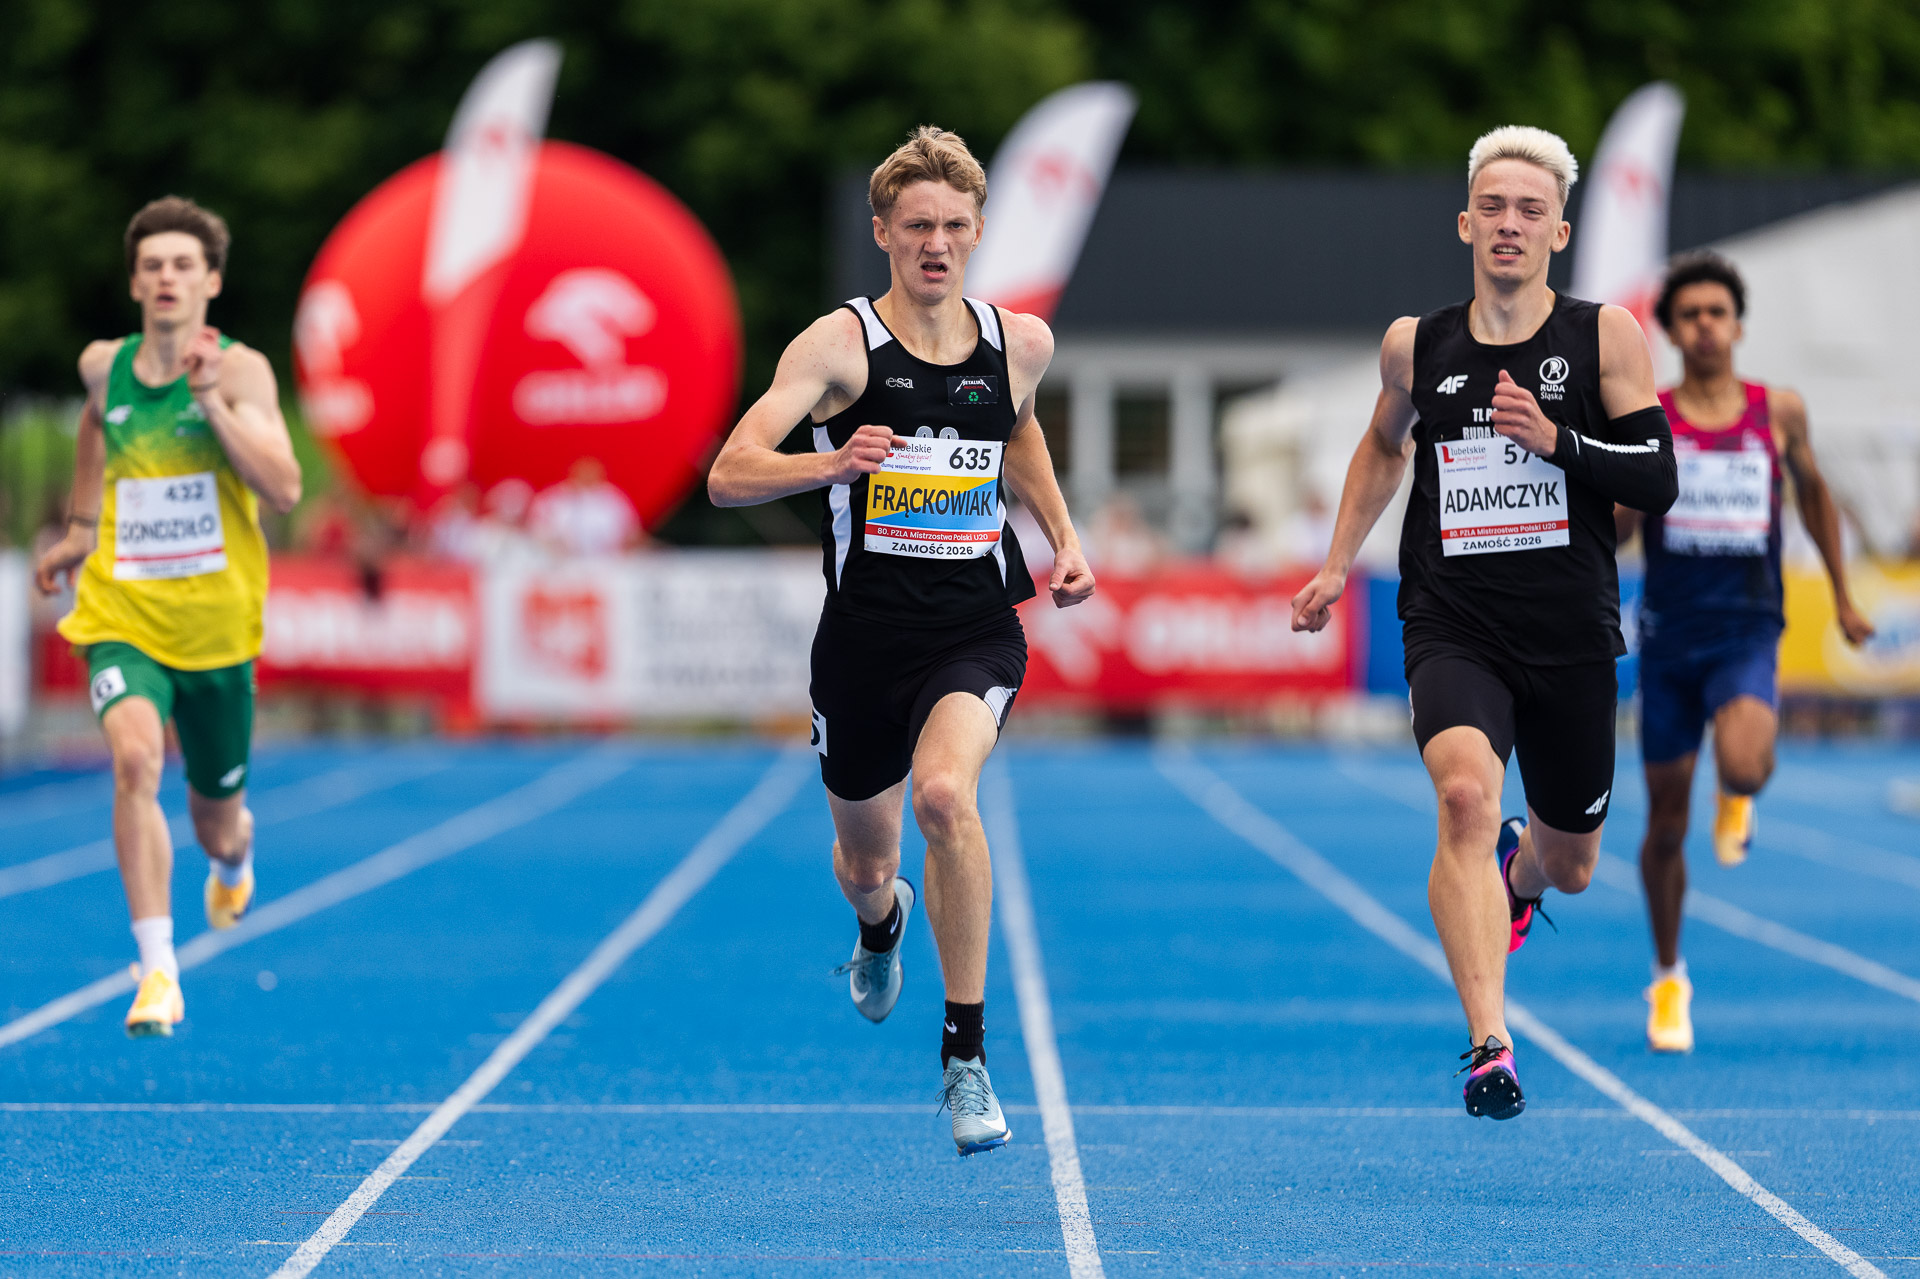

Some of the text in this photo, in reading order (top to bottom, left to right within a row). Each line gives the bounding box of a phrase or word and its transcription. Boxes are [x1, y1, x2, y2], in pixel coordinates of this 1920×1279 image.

[885, 377, 914, 389] esa
[1436, 374, 1469, 395] 4F
[1540, 384, 1566, 393] RUDA
[1540, 391, 1563, 401] Śląska
[1462, 426, 1492, 440] RUDA
[949, 447, 992, 471] 635
[872, 484, 993, 518] FRĄCKOWIAK
[1444, 481, 1560, 514] ADAMCZYK
[877, 527, 989, 541] 80. PZLA Mistrzostwa Polski U20
[1449, 522, 1557, 538] 80. PZLA Mistrzostwa Polski U20
[891, 541, 974, 556] ZAMOŚĆ 2026
[1462, 535, 1542, 551] ZAMOŚĆ 2026
[1585, 789, 1610, 815] 4F
